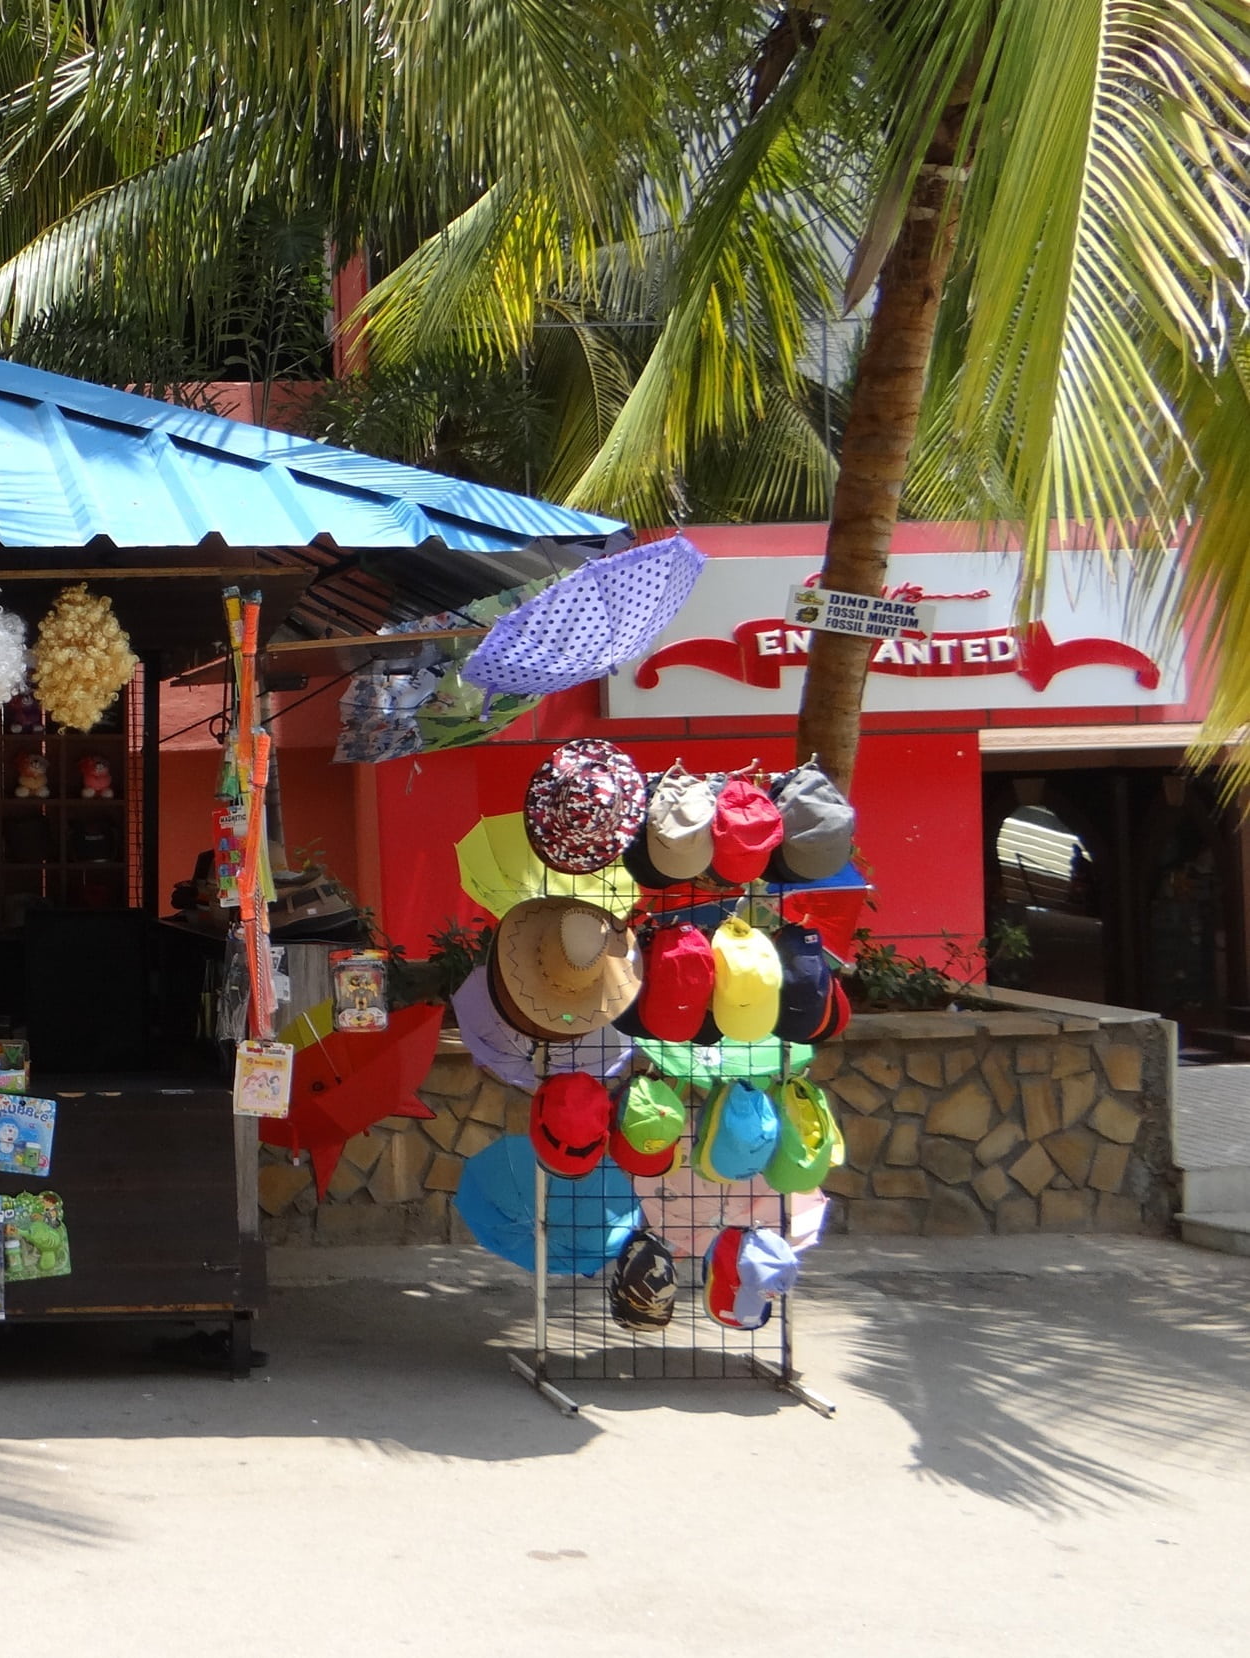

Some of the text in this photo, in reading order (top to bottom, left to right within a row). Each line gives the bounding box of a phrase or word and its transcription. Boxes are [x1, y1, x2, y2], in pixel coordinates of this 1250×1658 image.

[829, 594, 917, 616] DINO PARK
[825, 617, 897, 637] FOSSIL HUNT
[827, 605, 919, 628] FOSSIL MUSEUM
[756, 630, 1017, 665] ENANTED
